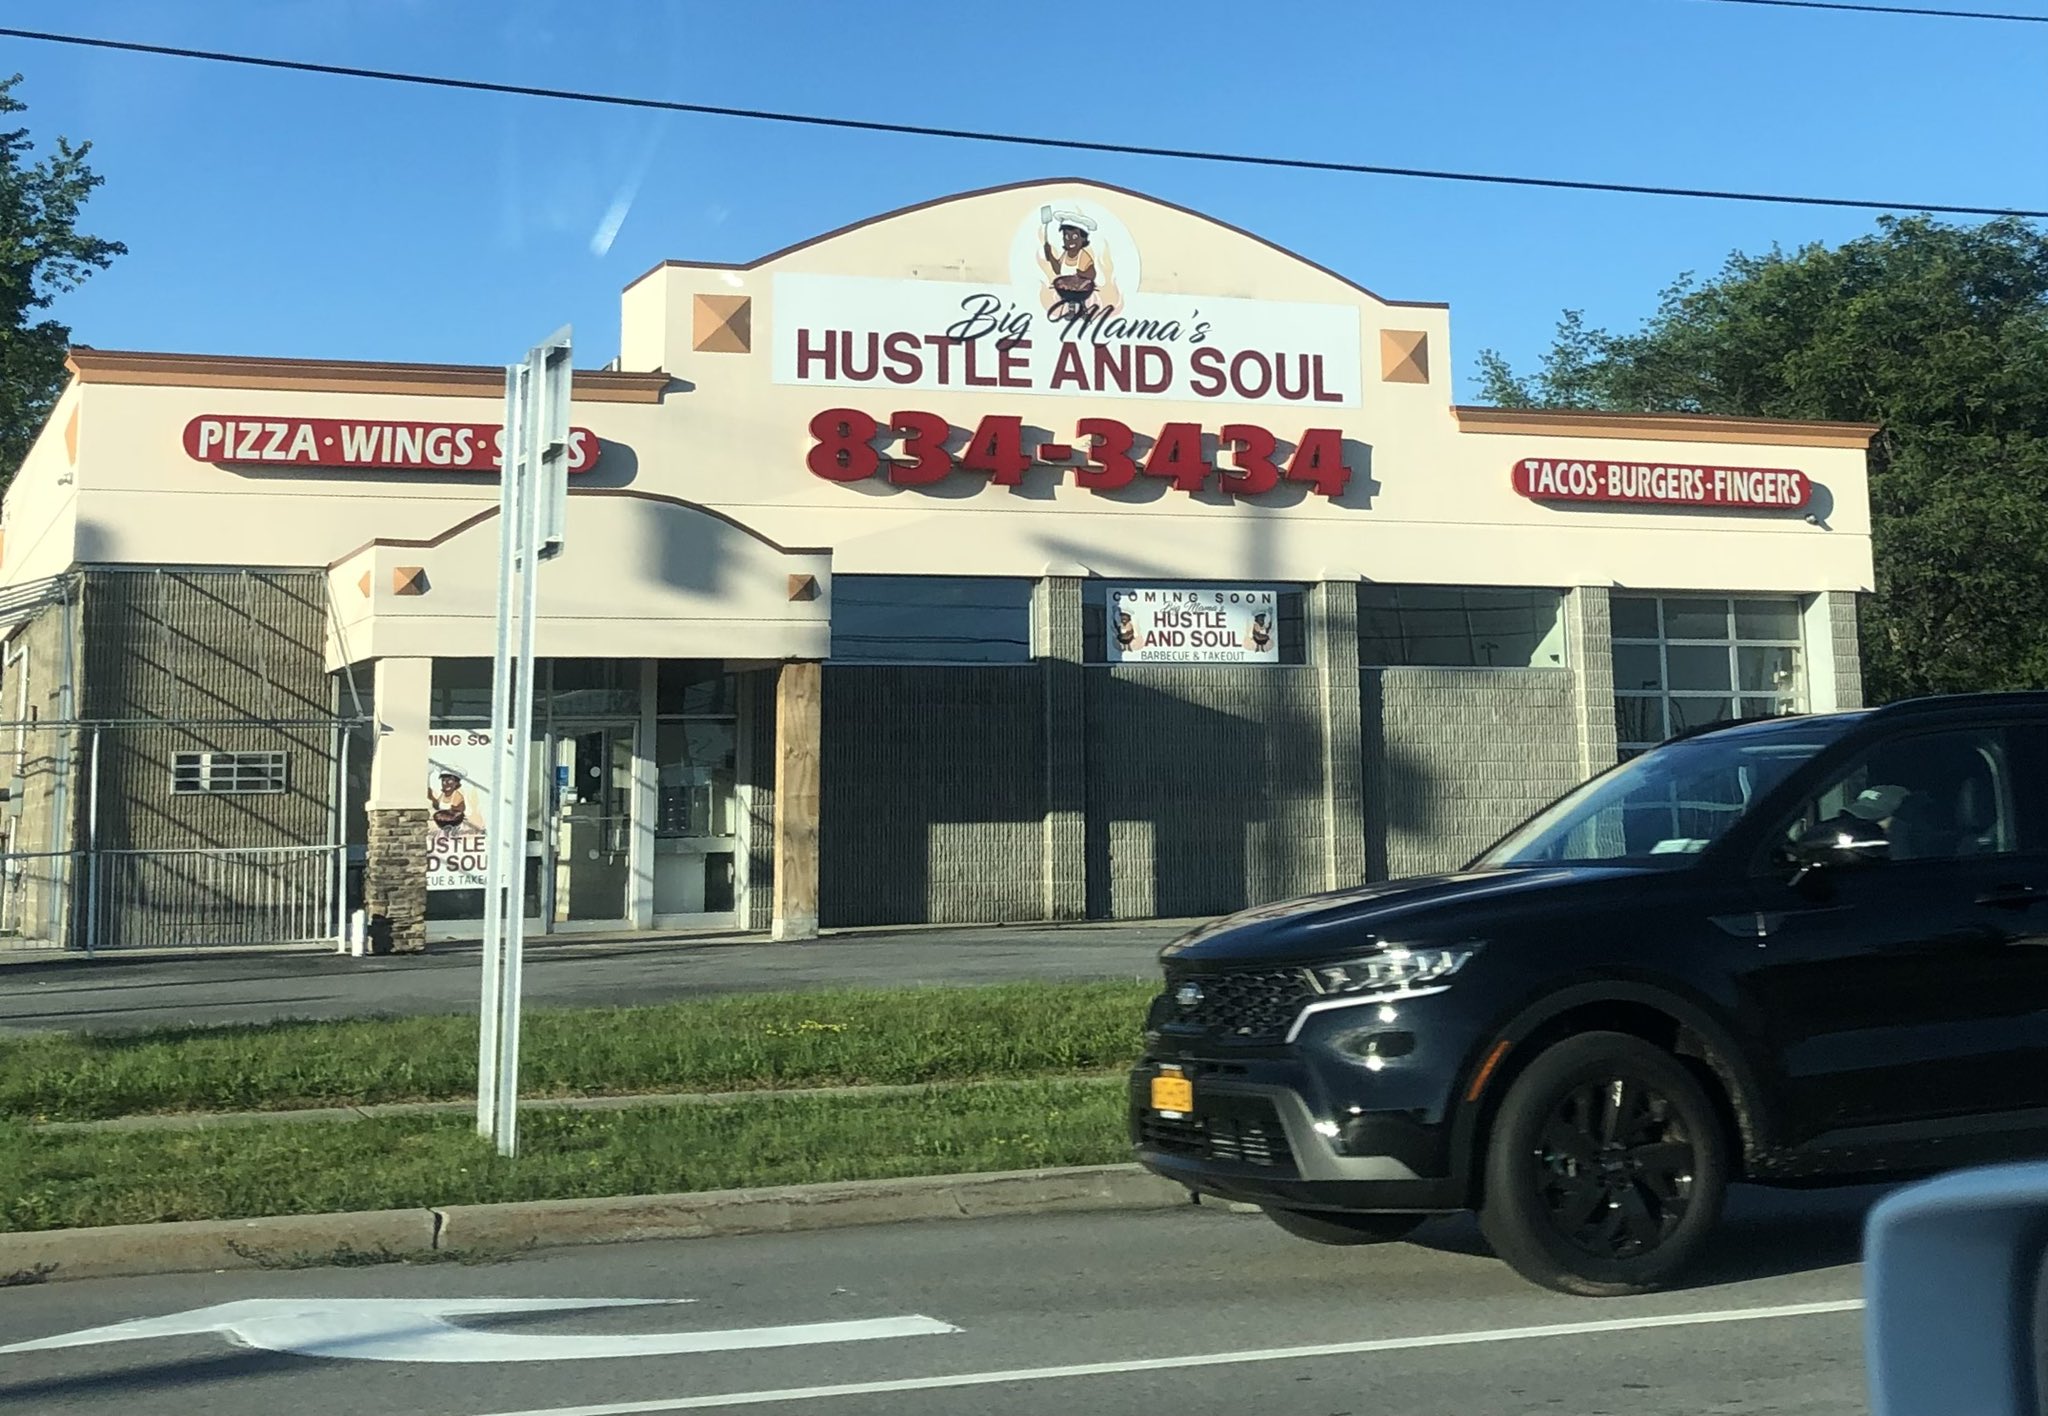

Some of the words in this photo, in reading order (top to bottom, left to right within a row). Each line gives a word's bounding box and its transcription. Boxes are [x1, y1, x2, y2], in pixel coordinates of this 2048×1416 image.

[946, 293, 1033, 351] Big
[1047, 298, 1212, 345] Mama's
[797, 329, 1032, 386] HUSTLE
[1050, 341, 1173, 394] AND
[1190, 347, 1344, 403] SOUL
[199, 421, 320, 462] PIZZA
[341, 425, 474, 466] WINGS
[806, 408, 1353, 497] 834-3434
[1524, 461, 1598, 496] TACOS
[1608, 464, 1705, 500] BURGERS
[1714, 470, 1801, 505] FINGERS
[1112, 591, 1198, 603] COMING
[1215, 592, 1271, 604] SOON
[1154, 611, 1227, 628] HUSTLE
[1144, 630, 1185, 647] AND
[1190, 631, 1242, 647] SOUL
[1141, 651, 1190, 661] BARBECUE
[1193, 652, 1200, 661] &
[1203, 651, 1245, 661] TAKEOUT
[446, 855, 488, 872] SOU
